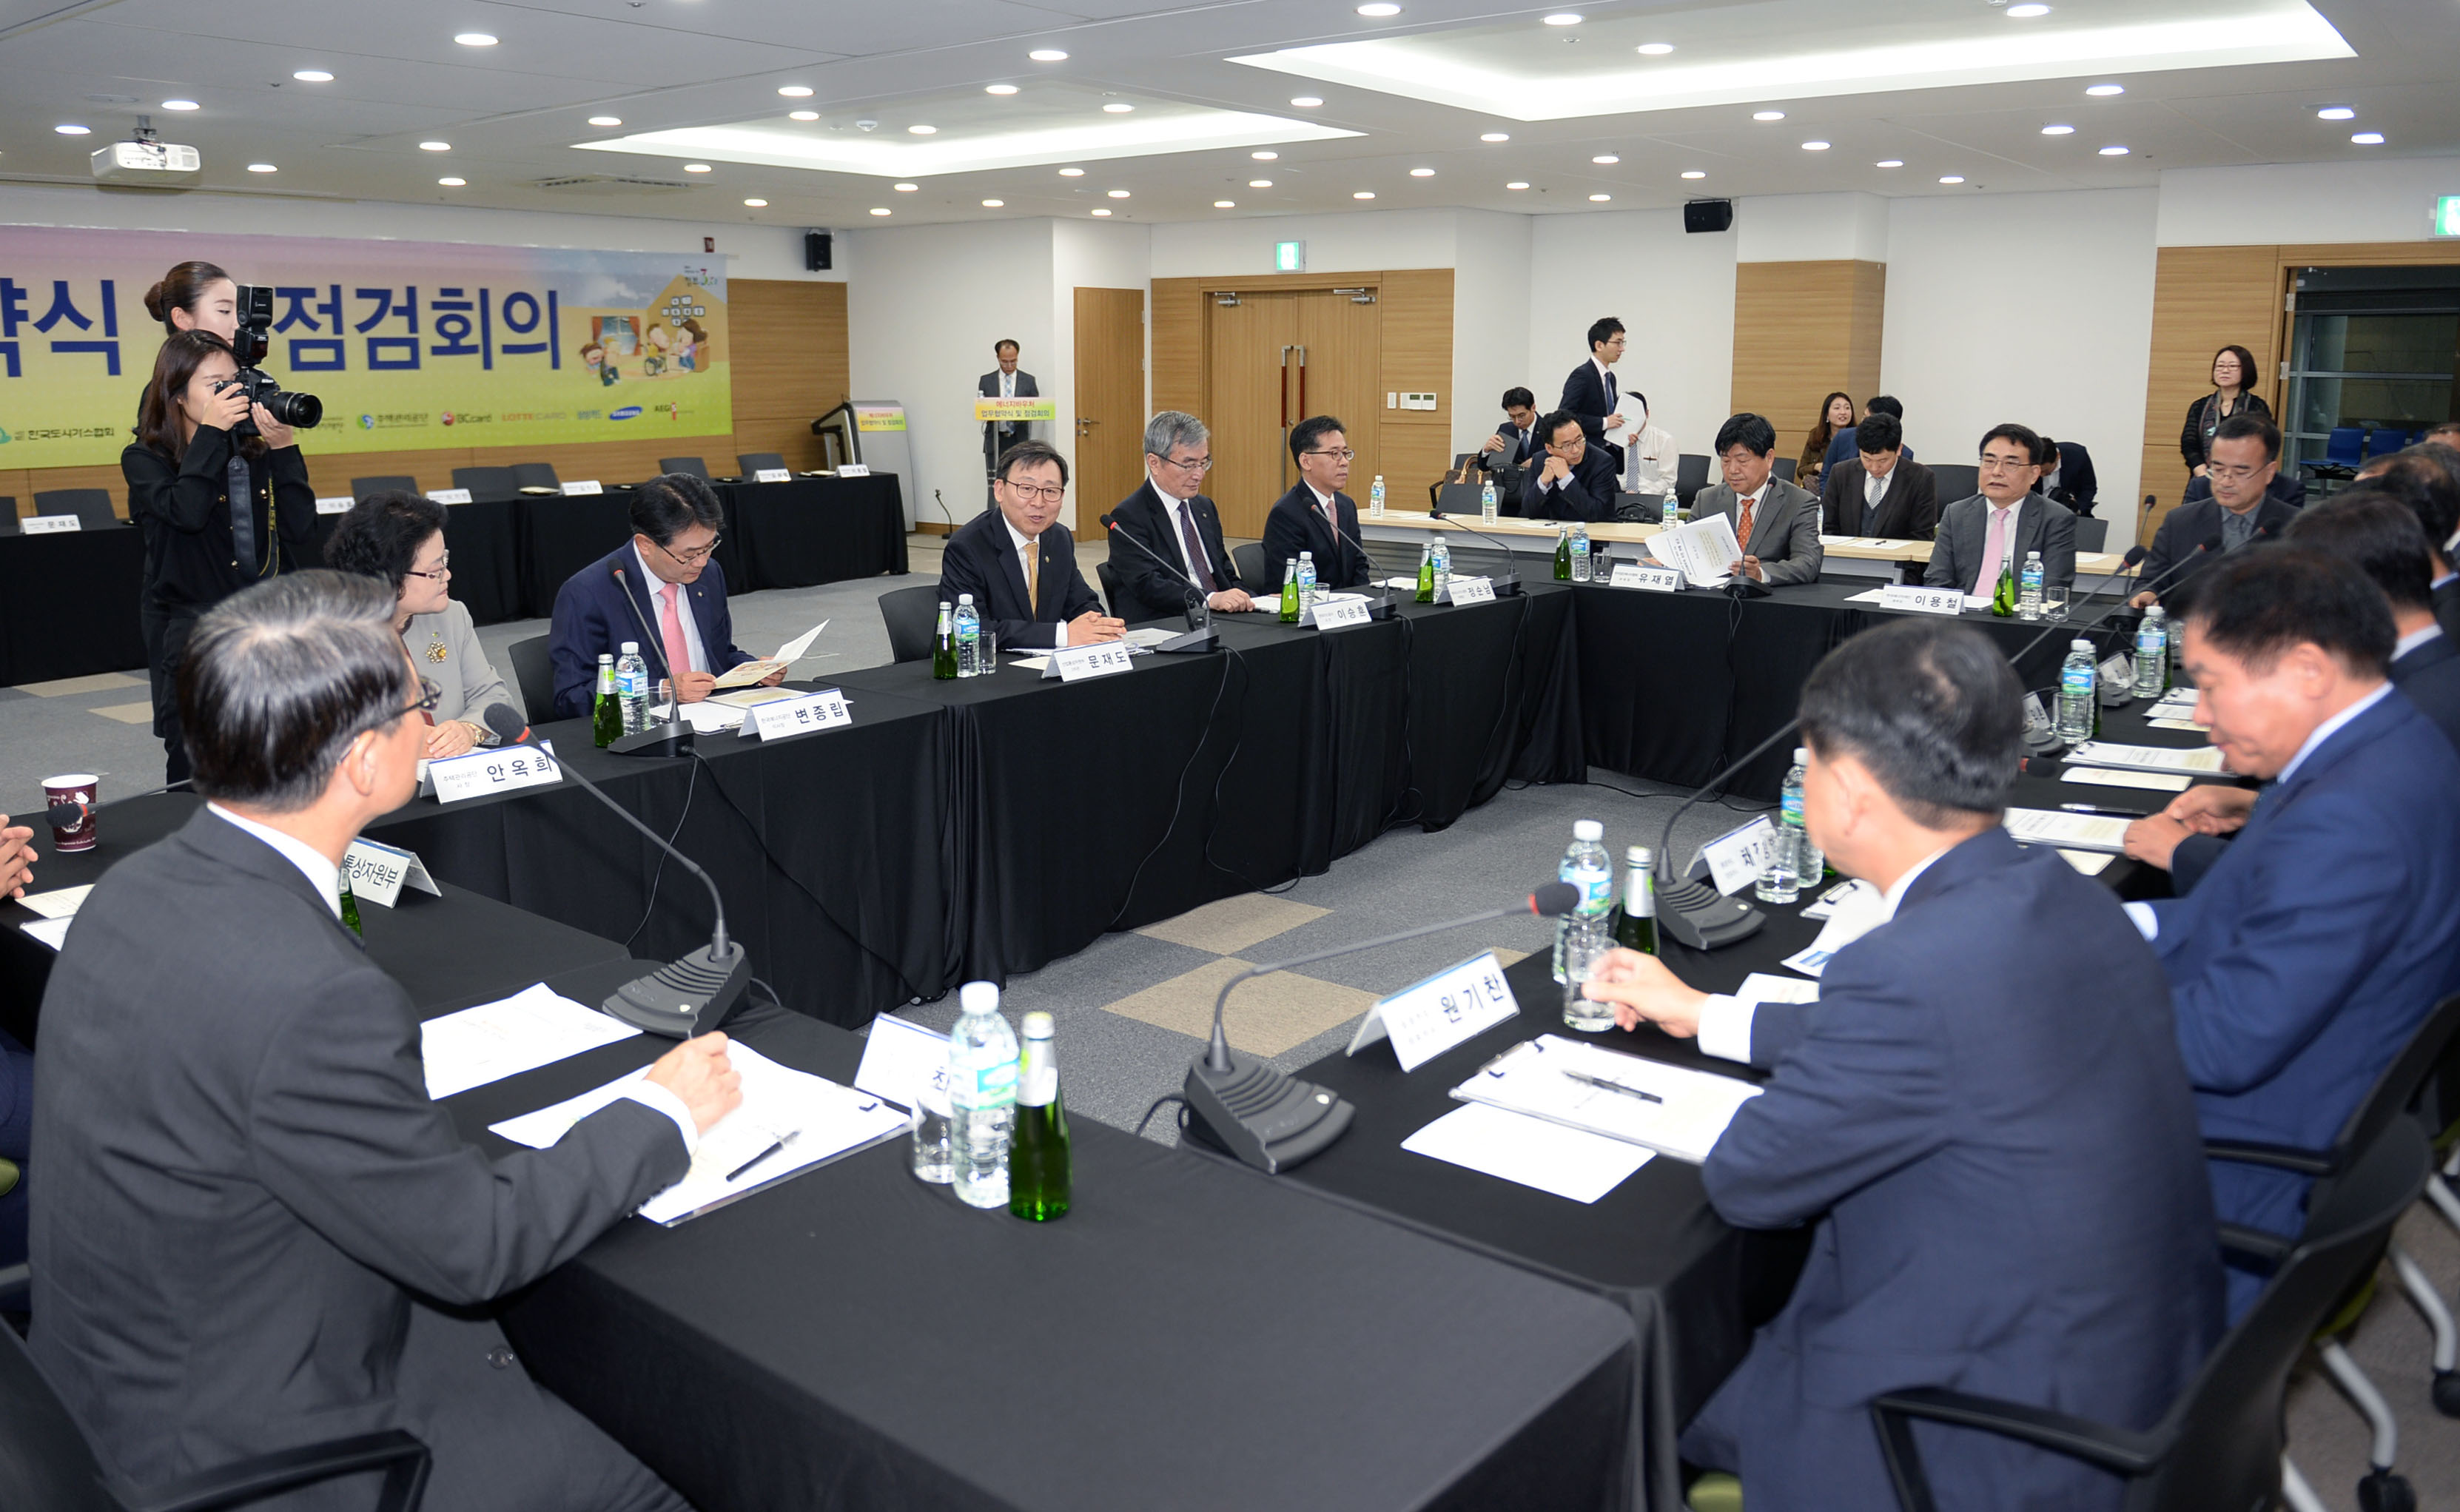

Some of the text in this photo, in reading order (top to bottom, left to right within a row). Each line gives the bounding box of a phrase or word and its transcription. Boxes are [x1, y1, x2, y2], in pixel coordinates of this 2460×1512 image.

[272, 284, 560, 371] 점검회의
[502, 413, 533, 421] LOTTE
[981, 409, 1049, 417] 업무협약식 및 점검회의
[28, 428, 115, 440] 한국도시가스협회
[1639, 573, 1674, 586] 유재열
[1468, 584, 1492, 598] 정순남
[1915, 594, 1958, 610] 이용철
[1337, 605, 1367, 619] 이승훈
[1088, 650, 1127, 669] 문재도
[795, 701, 844, 725] 변종립
[487, 753, 553, 782] 안옥희
[345, 854, 399, 889] 통상자원부
[1441, 973, 1505, 1024] 원기찬
